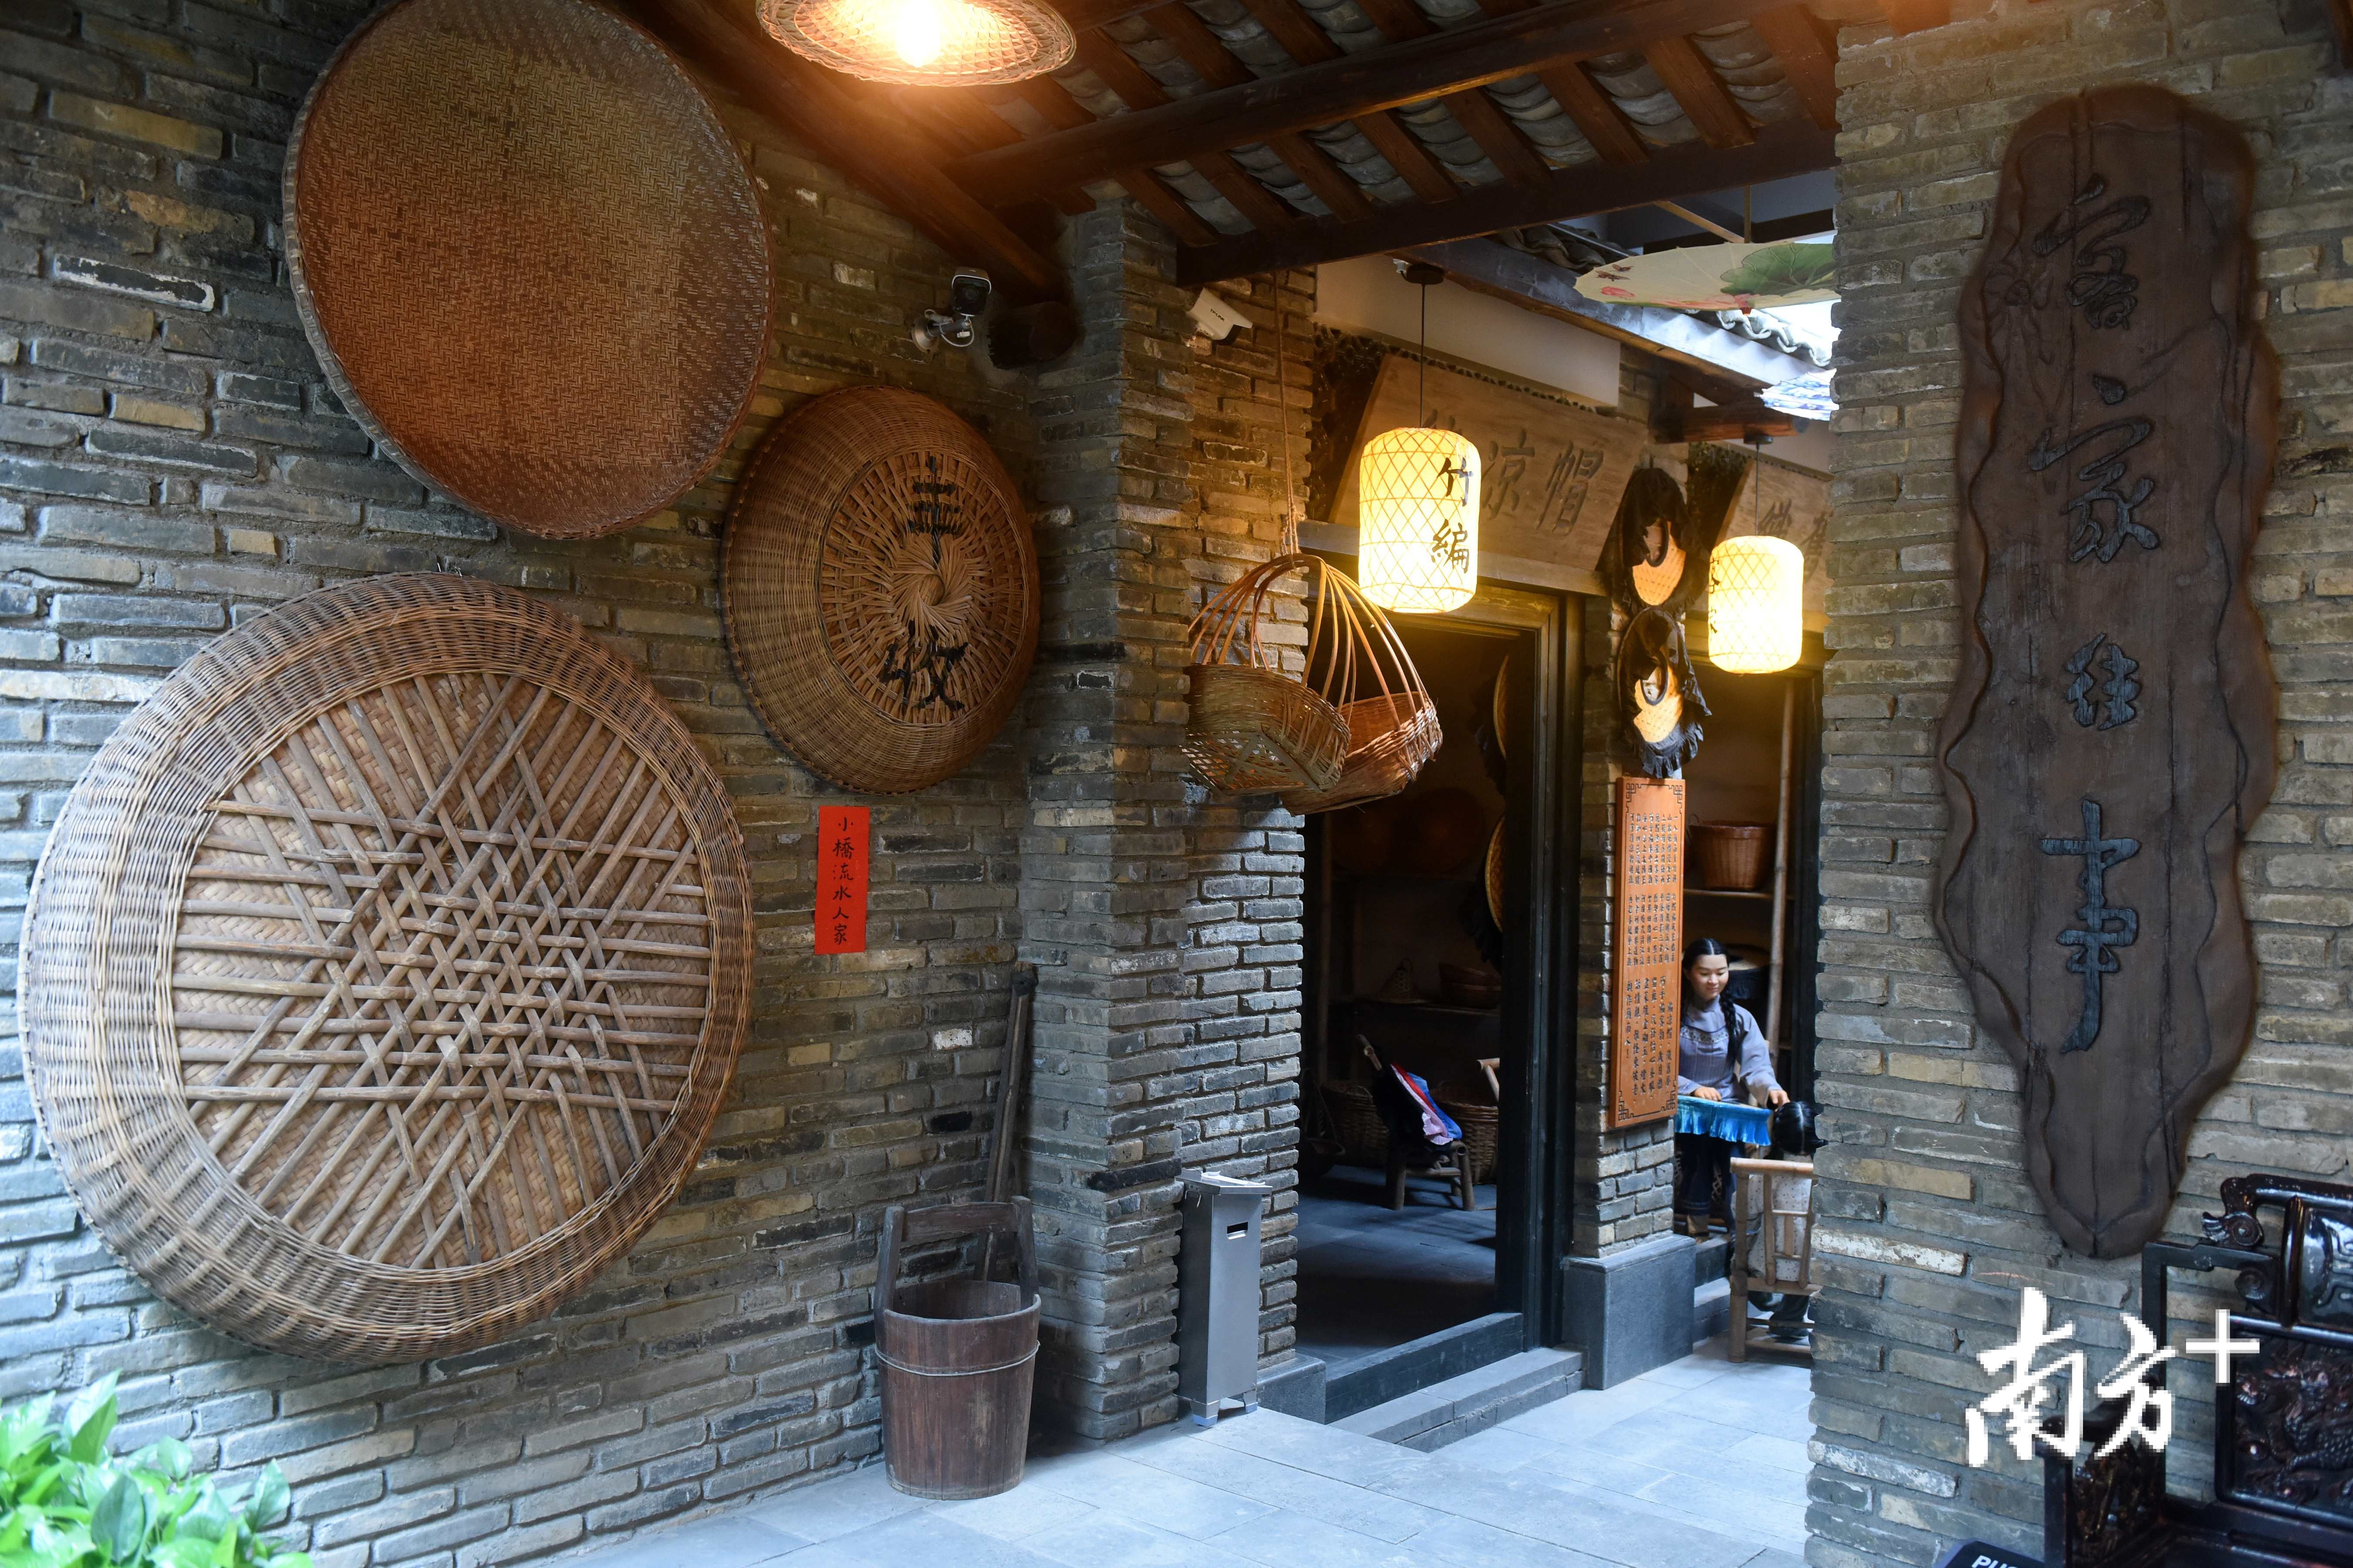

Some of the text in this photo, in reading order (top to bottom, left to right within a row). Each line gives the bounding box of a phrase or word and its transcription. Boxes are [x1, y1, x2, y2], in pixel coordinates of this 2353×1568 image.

[832, 816, 855, 945] 小橋流水人家
